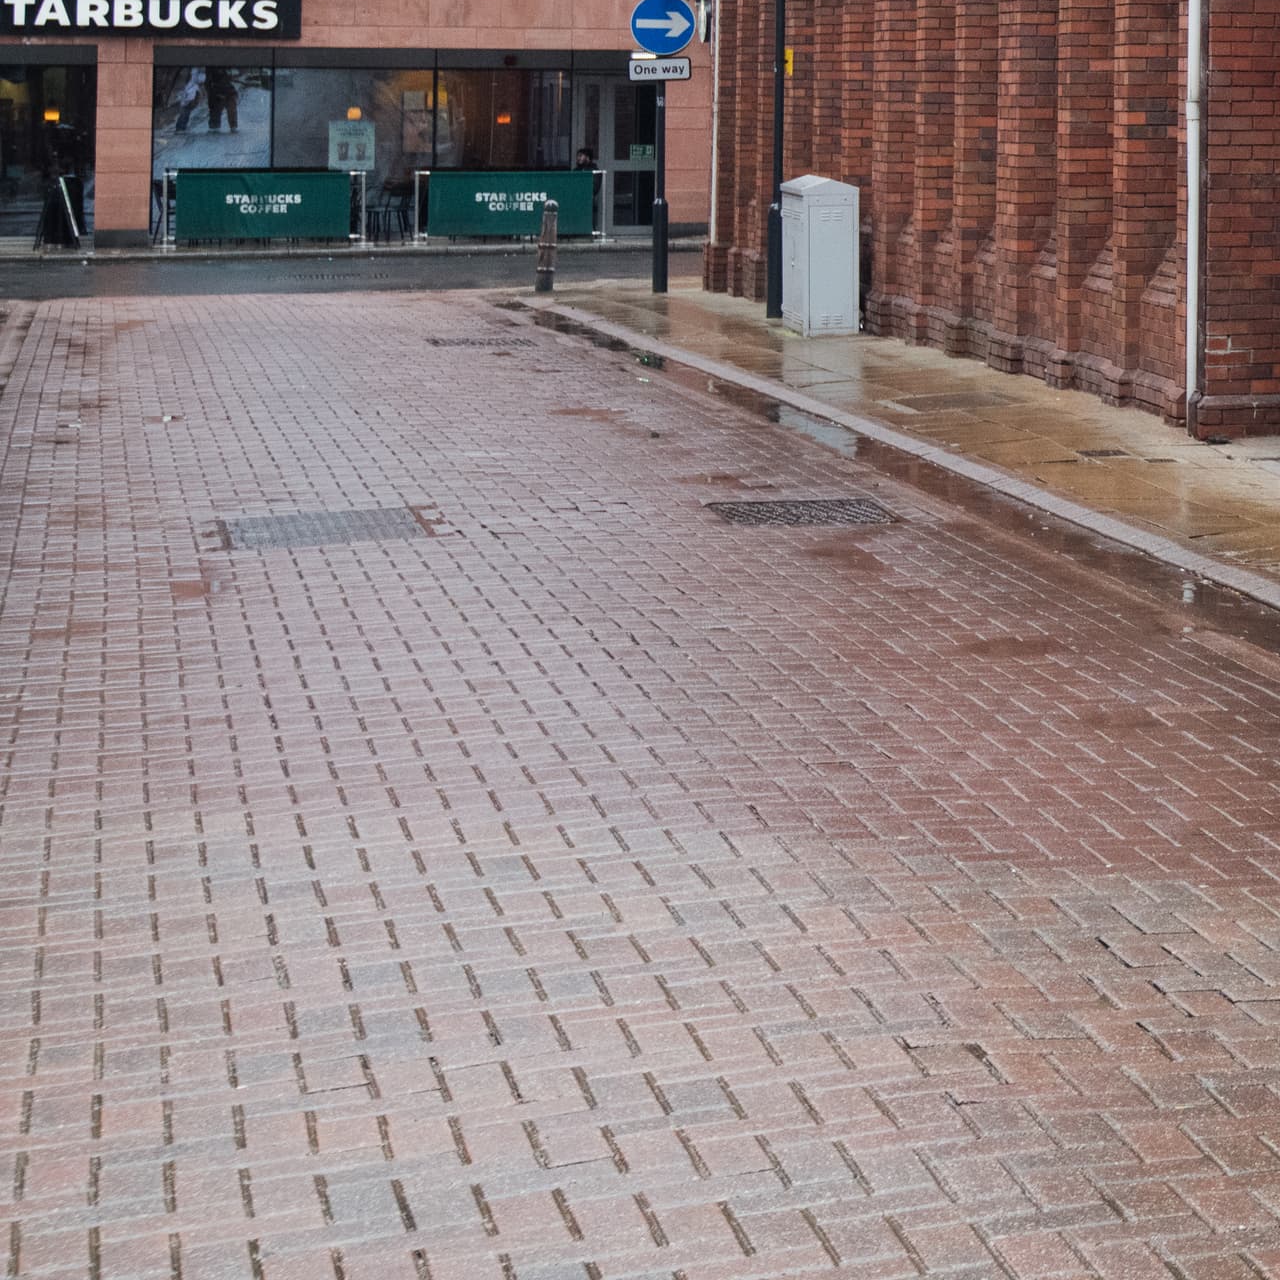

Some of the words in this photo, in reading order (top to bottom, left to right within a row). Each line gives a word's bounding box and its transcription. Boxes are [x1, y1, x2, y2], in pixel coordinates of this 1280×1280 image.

[633, 64, 658, 75] One
[661, 64, 685, 75] way
[226, 193, 302, 204] STARUCKS
[475, 192, 547, 202] STARUCKS
